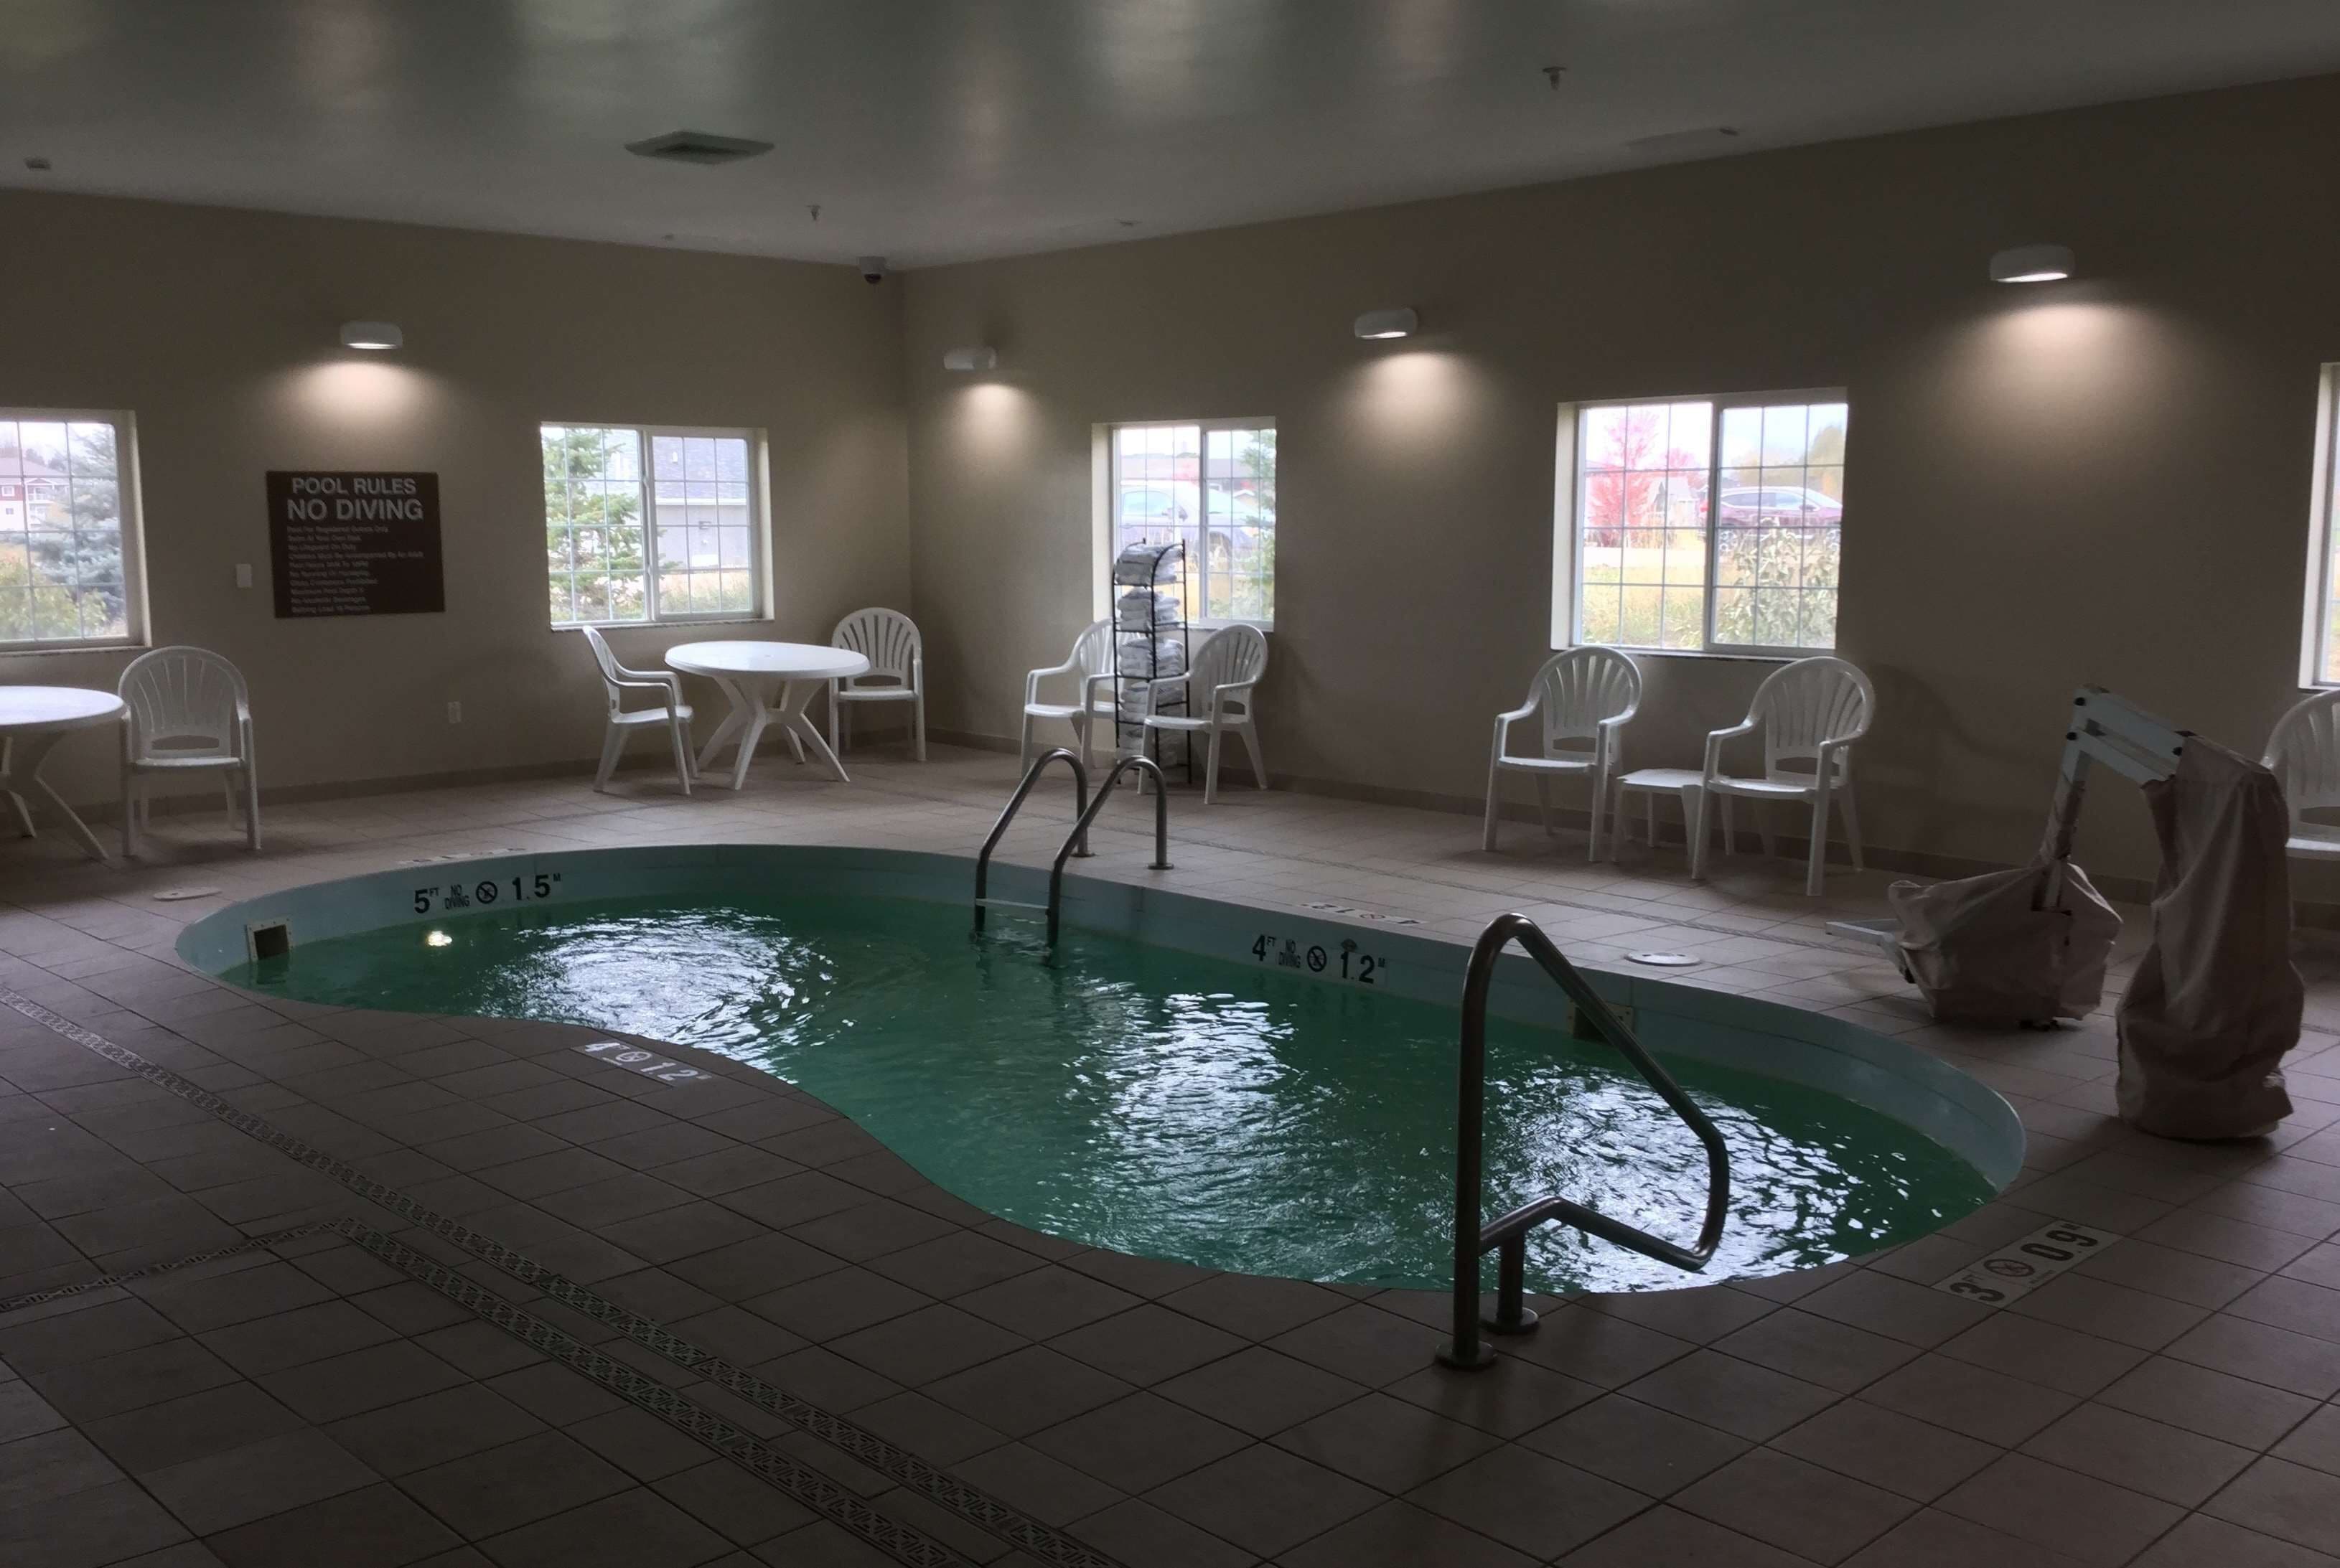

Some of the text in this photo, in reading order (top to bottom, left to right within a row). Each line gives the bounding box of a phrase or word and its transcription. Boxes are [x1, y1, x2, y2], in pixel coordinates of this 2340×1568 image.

[291, 477, 416, 495] POOL RULES
[286, 498, 424, 521] NO DIVING
[450, 884, 462, 896] NO
[444, 895, 470, 909] DIVING
